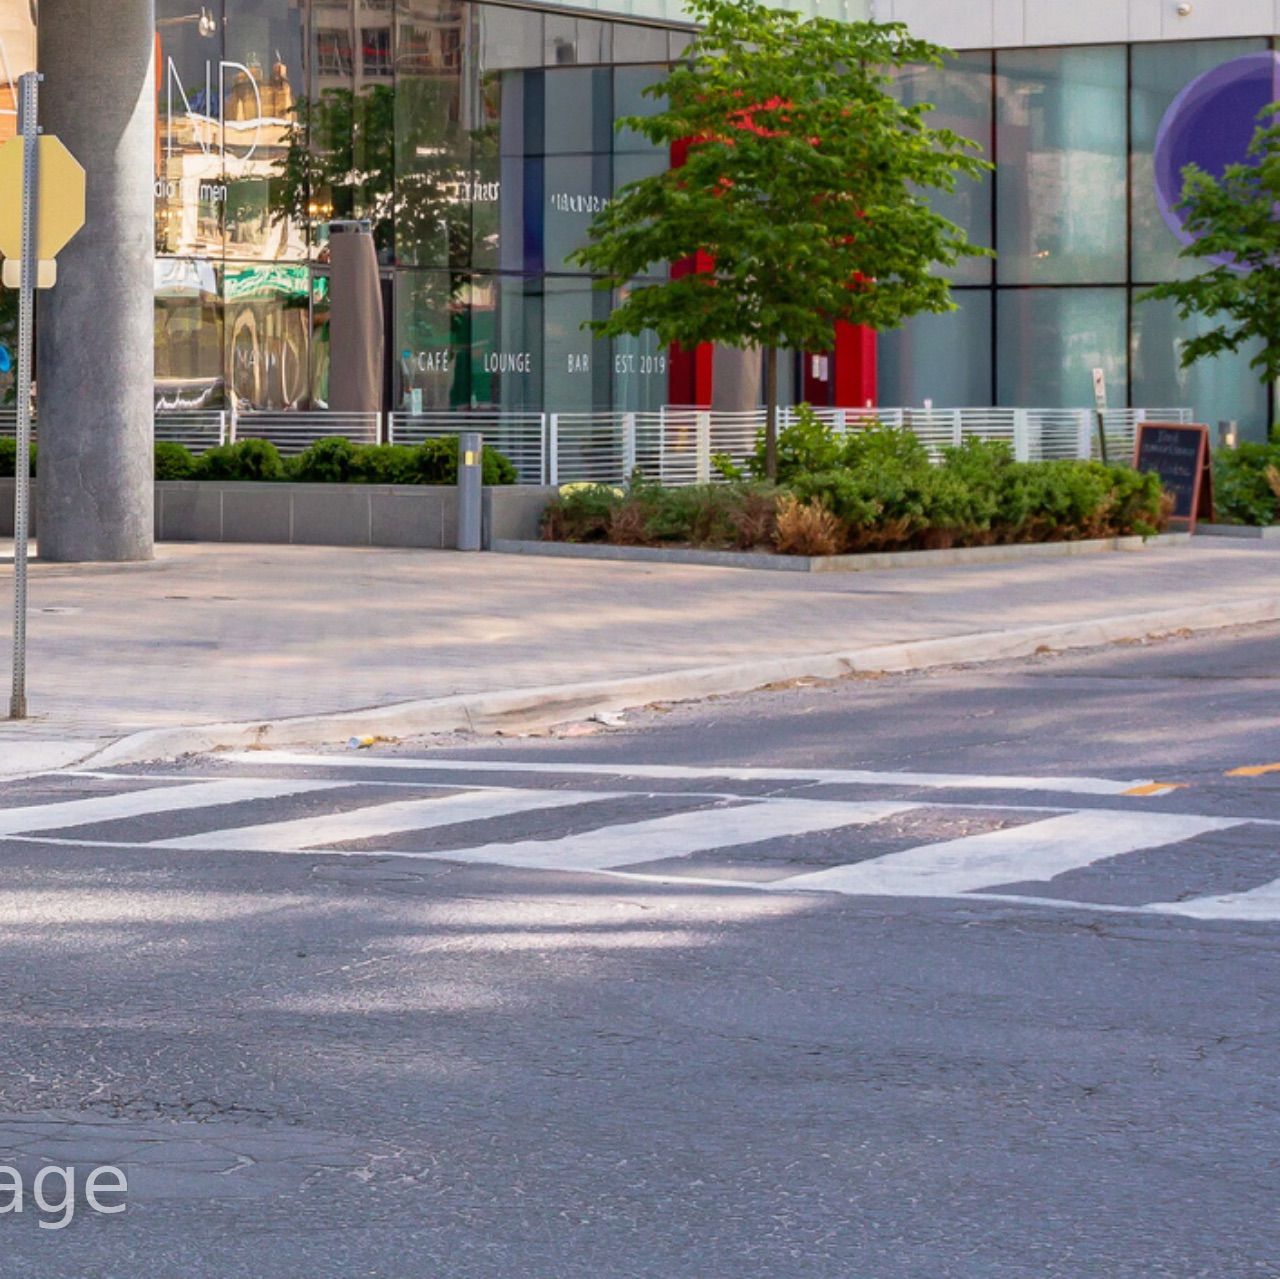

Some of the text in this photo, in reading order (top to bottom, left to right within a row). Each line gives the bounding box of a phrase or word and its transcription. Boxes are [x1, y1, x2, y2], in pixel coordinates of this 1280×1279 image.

[417, 349, 449, 372] CAFÉ
[484, 352, 531, 373] LOUNGE
[567, 353, 589, 373] BAR
[640, 354, 666, 374] 2019
